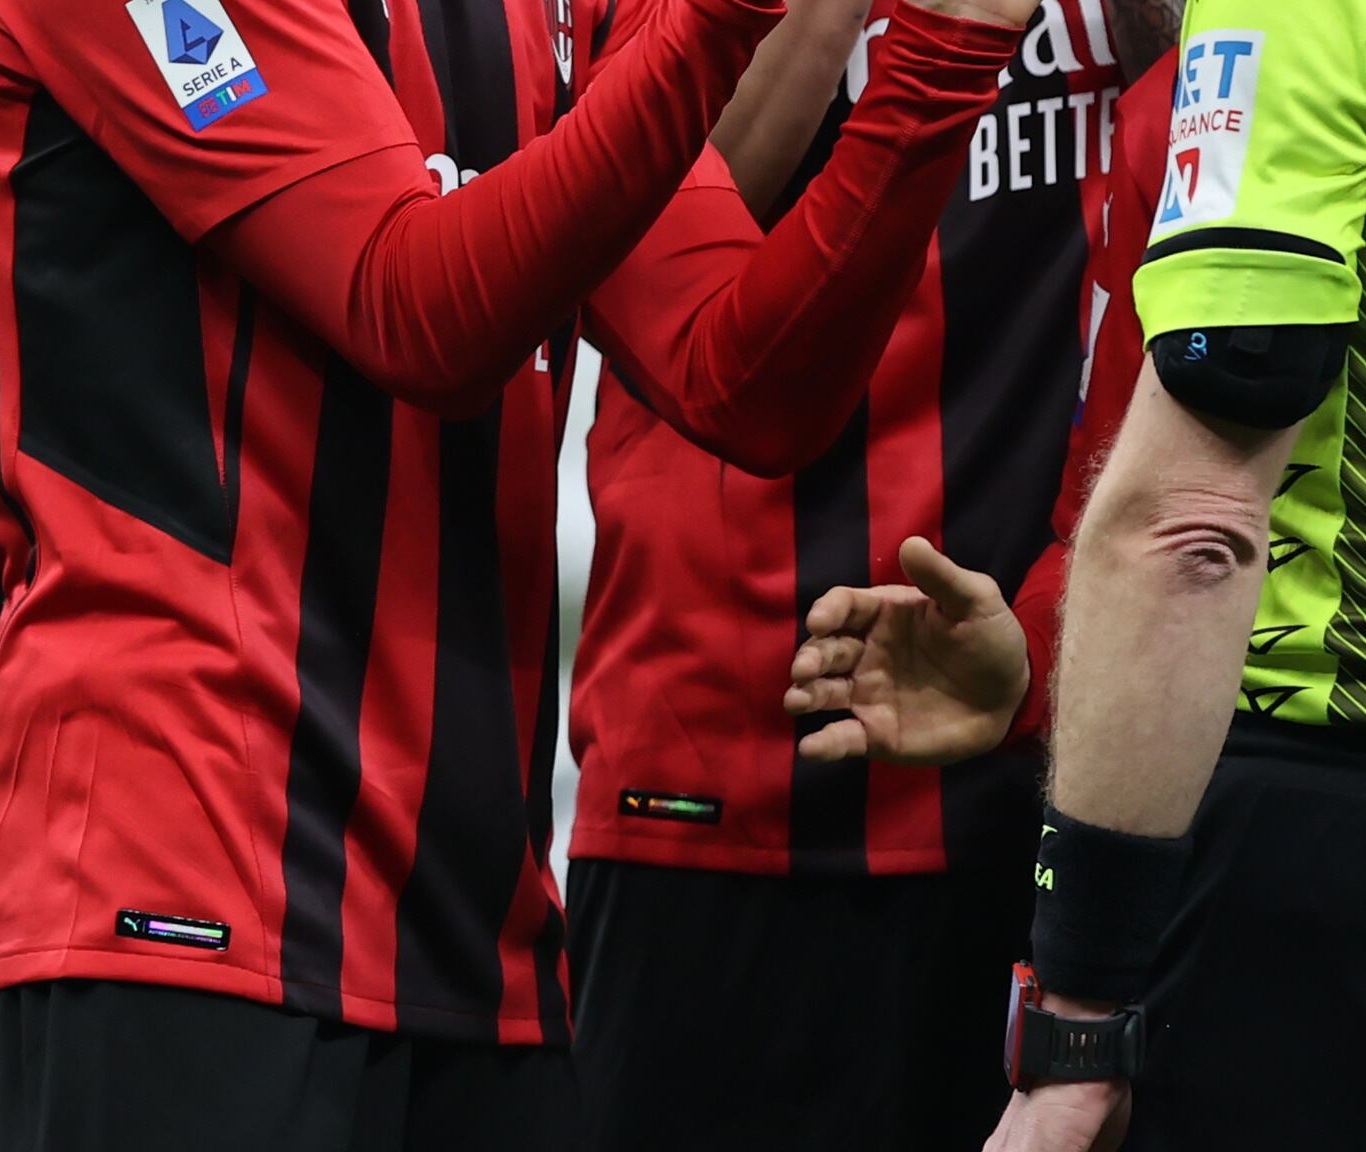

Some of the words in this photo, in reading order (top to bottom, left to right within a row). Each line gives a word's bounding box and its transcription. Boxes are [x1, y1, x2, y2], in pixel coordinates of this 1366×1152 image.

[182, 63, 228, 97] SERIE
[230, 56, 243, 71] A
[215, 79, 252, 106] TIM
[969, 86, 1120, 202] BETTE
[1168, 109, 1244, 148] URANCE
